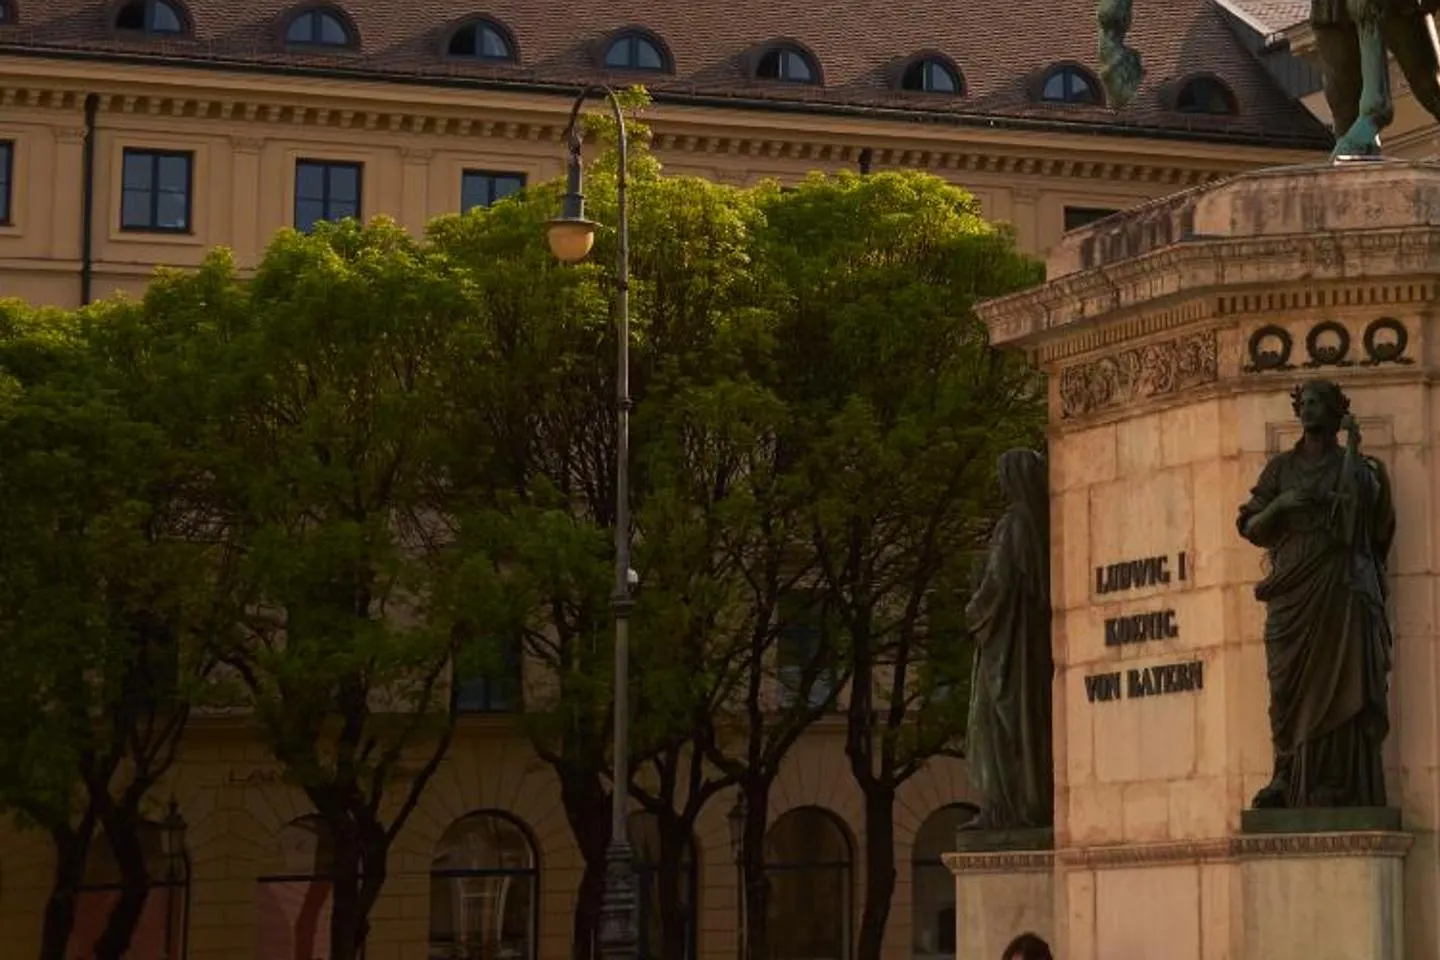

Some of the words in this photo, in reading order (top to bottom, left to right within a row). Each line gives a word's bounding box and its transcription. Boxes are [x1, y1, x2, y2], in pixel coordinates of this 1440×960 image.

[1096, 555, 1171, 594] LUDWIG
[1084, 671, 1121, 703] VON
[1127, 661, 1204, 698] BAYERN
